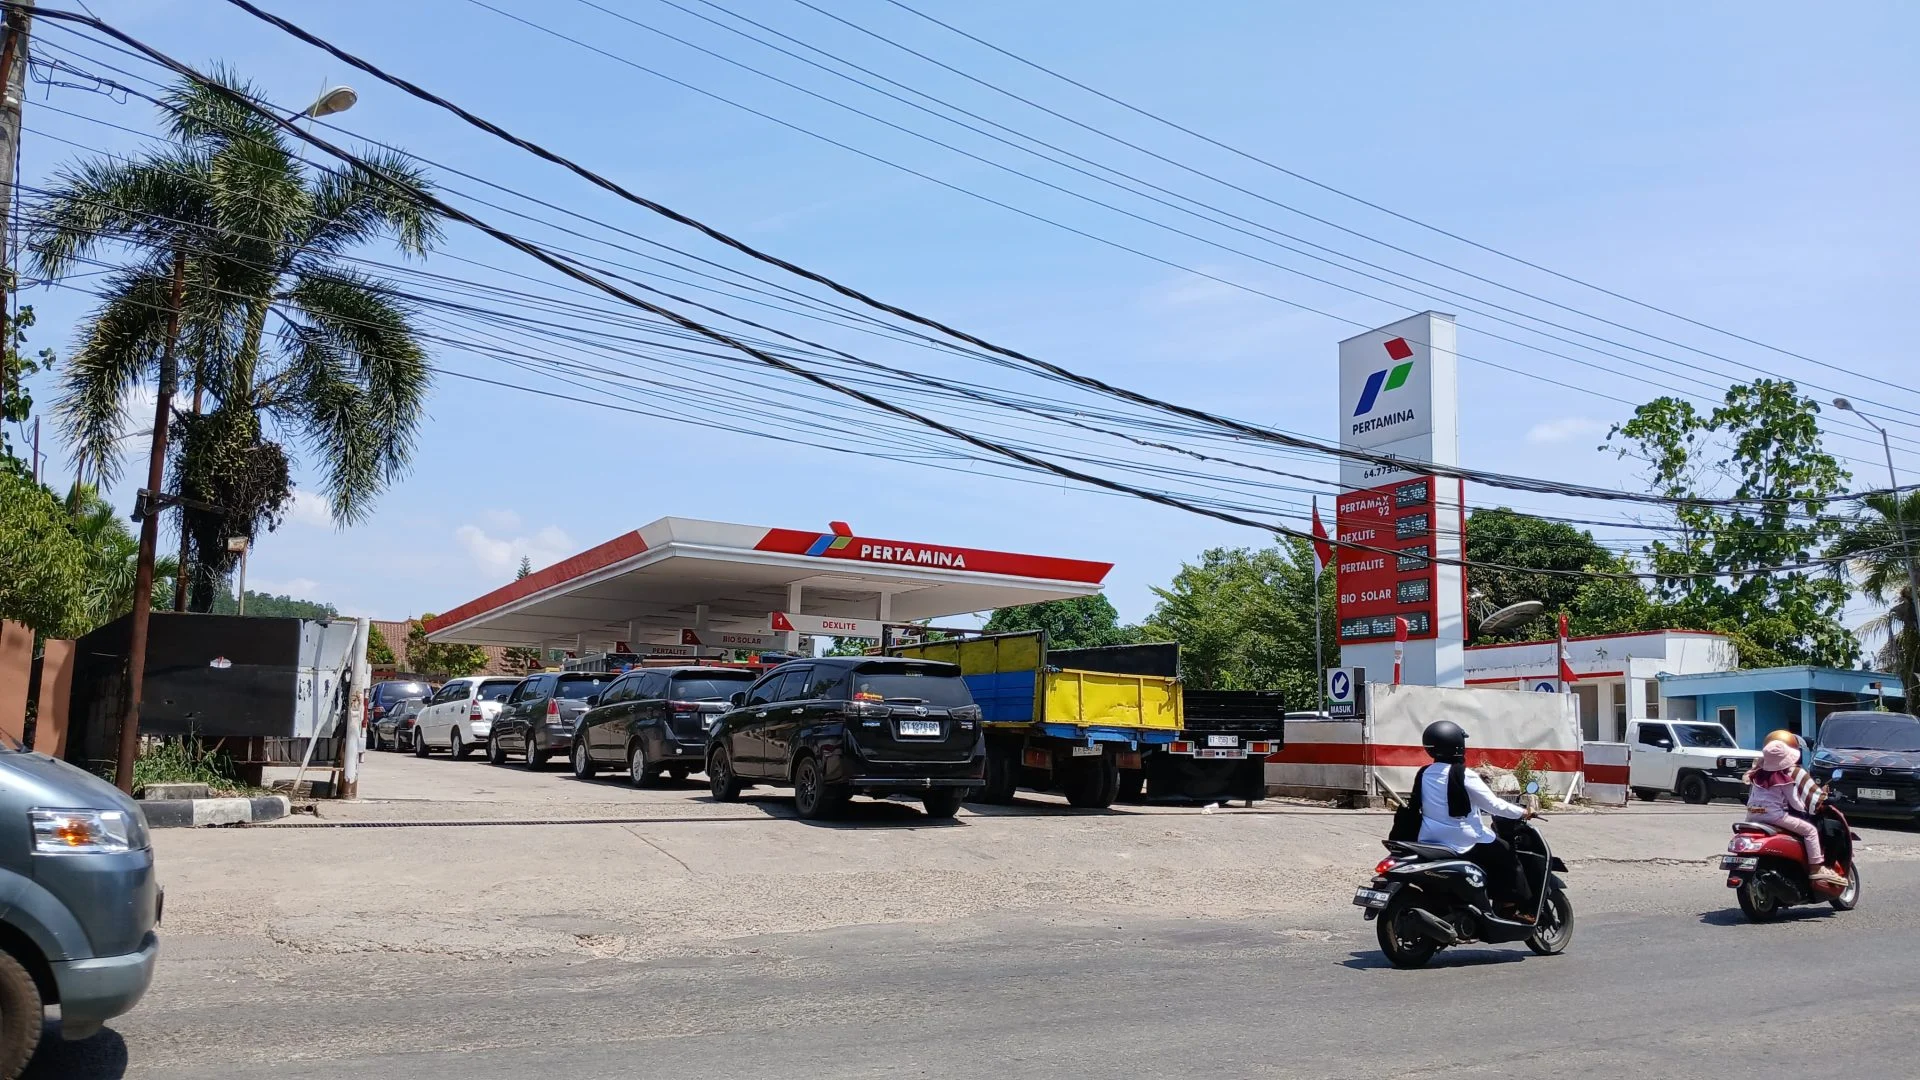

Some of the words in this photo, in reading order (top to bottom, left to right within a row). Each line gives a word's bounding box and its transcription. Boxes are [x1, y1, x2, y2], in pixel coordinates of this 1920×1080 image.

[1352, 409, 1415, 436] PERTAMINA
[1340, 495, 1389, 514] PERTAMAX
[1378, 506, 1390, 517] 92
[1340, 529, 1376, 543] DEXLITE
[861, 544, 966, 568] PERTAMINA
[1340, 558, 1385, 574] PERTALITE
[1341, 593, 1357, 604] BIO
[1361, 588, 1392, 601] SOLAR
[777, 616, 783, 626] 1
[822, 620, 857, 631] DEXLITE
[723, 636, 737, 644] BIO
[738, 637, 762, 645] SOLAR
[652, 647, 687, 655] PERTALITE
[1330, 703, 1351, 714] MASUK
